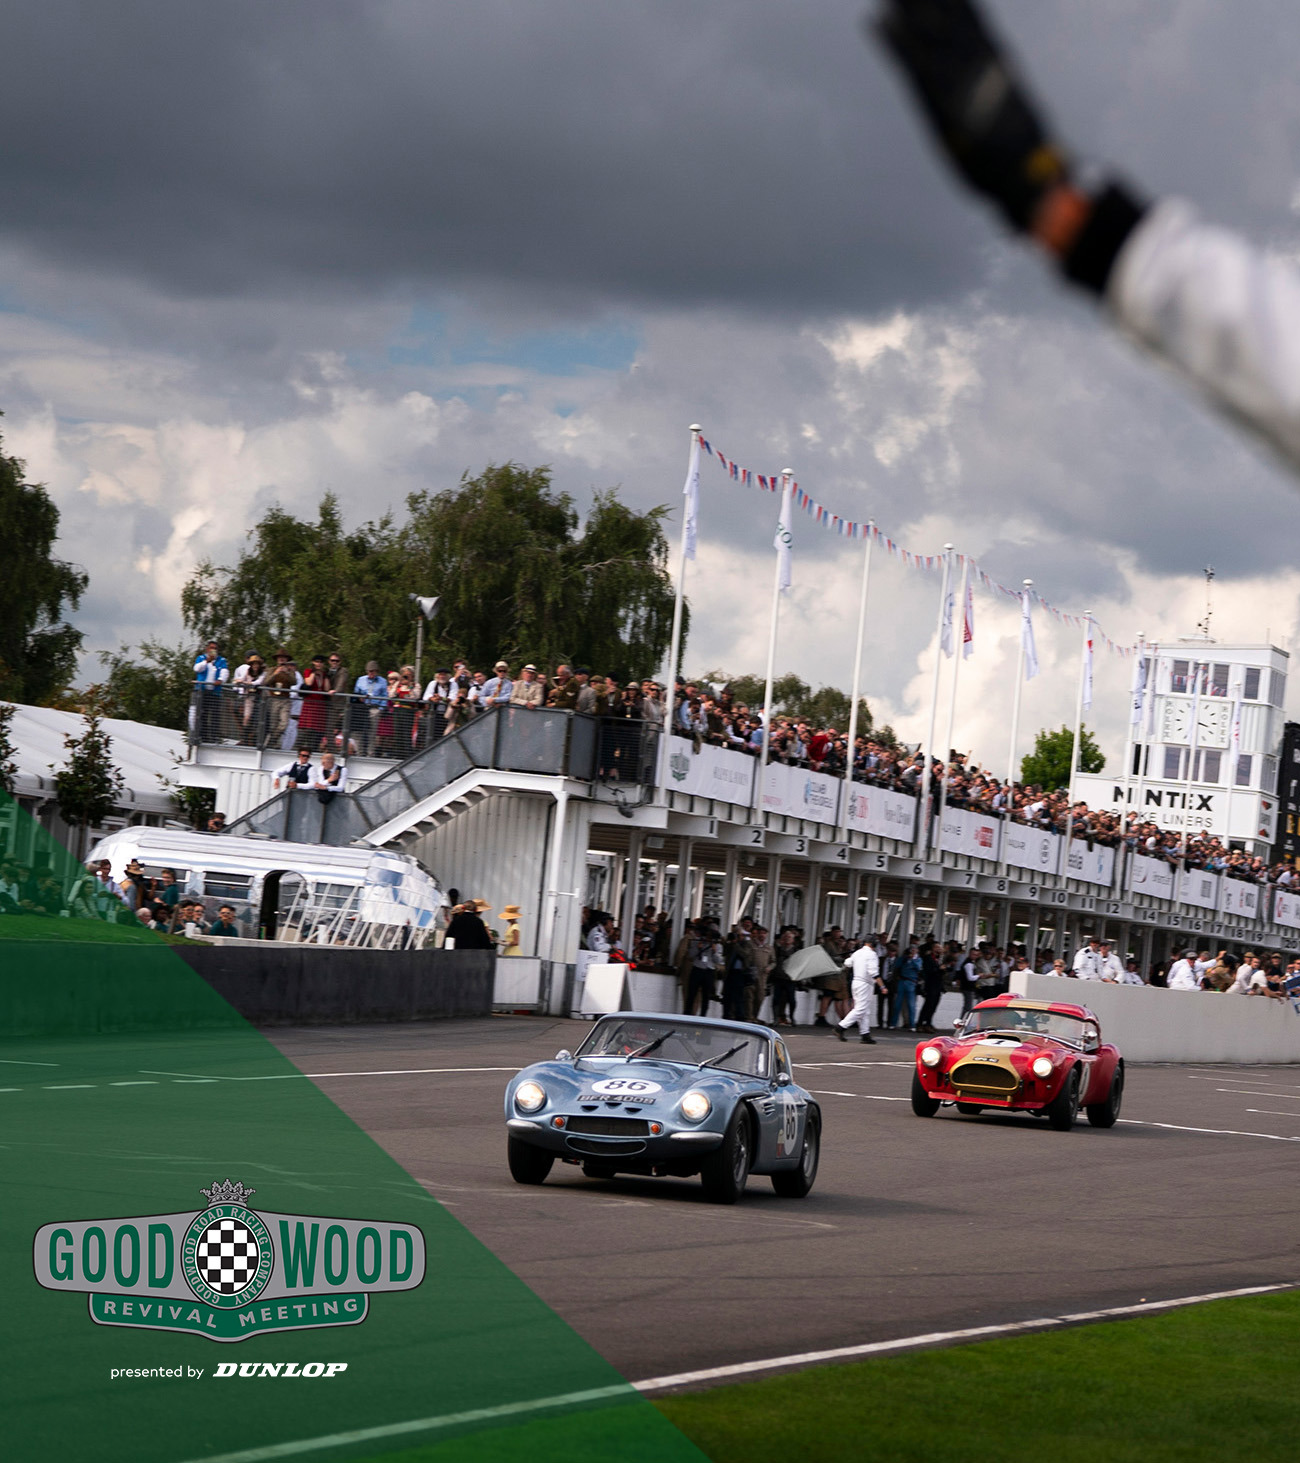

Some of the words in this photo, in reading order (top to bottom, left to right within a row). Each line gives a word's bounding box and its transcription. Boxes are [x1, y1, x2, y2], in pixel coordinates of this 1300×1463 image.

[1113, 785, 1214, 812] MNTEX
[1162, 813, 1213, 828] LINERS
[709, 820, 714, 834] 1
[751, 829, 762, 843] 2
[795, 839, 805, 852] 3
[836, 847, 847, 860] 4
[875, 855, 885, 868] 5
[912, 863, 923, 875] 6
[965, 873, 974, 885] 7
[997, 880, 1006, 891] 8
[1029, 887, 1037, 898] 9
[1051, 891, 1066, 903] 10
[1081, 897, 1094, 909] 11
[1106, 902, 1120, 914] 12
[1142, 910, 1156, 921] 14
[1167, 915, 1180, 926] 15
[1188, 920, 1201, 930] 16
[1210, 924, 1222, 934] 17
[1231, 928, 1244, 938] 18
[1252, 932, 1264, 942] 19
[1284, 939, 1298, 949] 20
[603, 1080, 650, 1091] 86
[785, 1103, 796, 1140] 86
